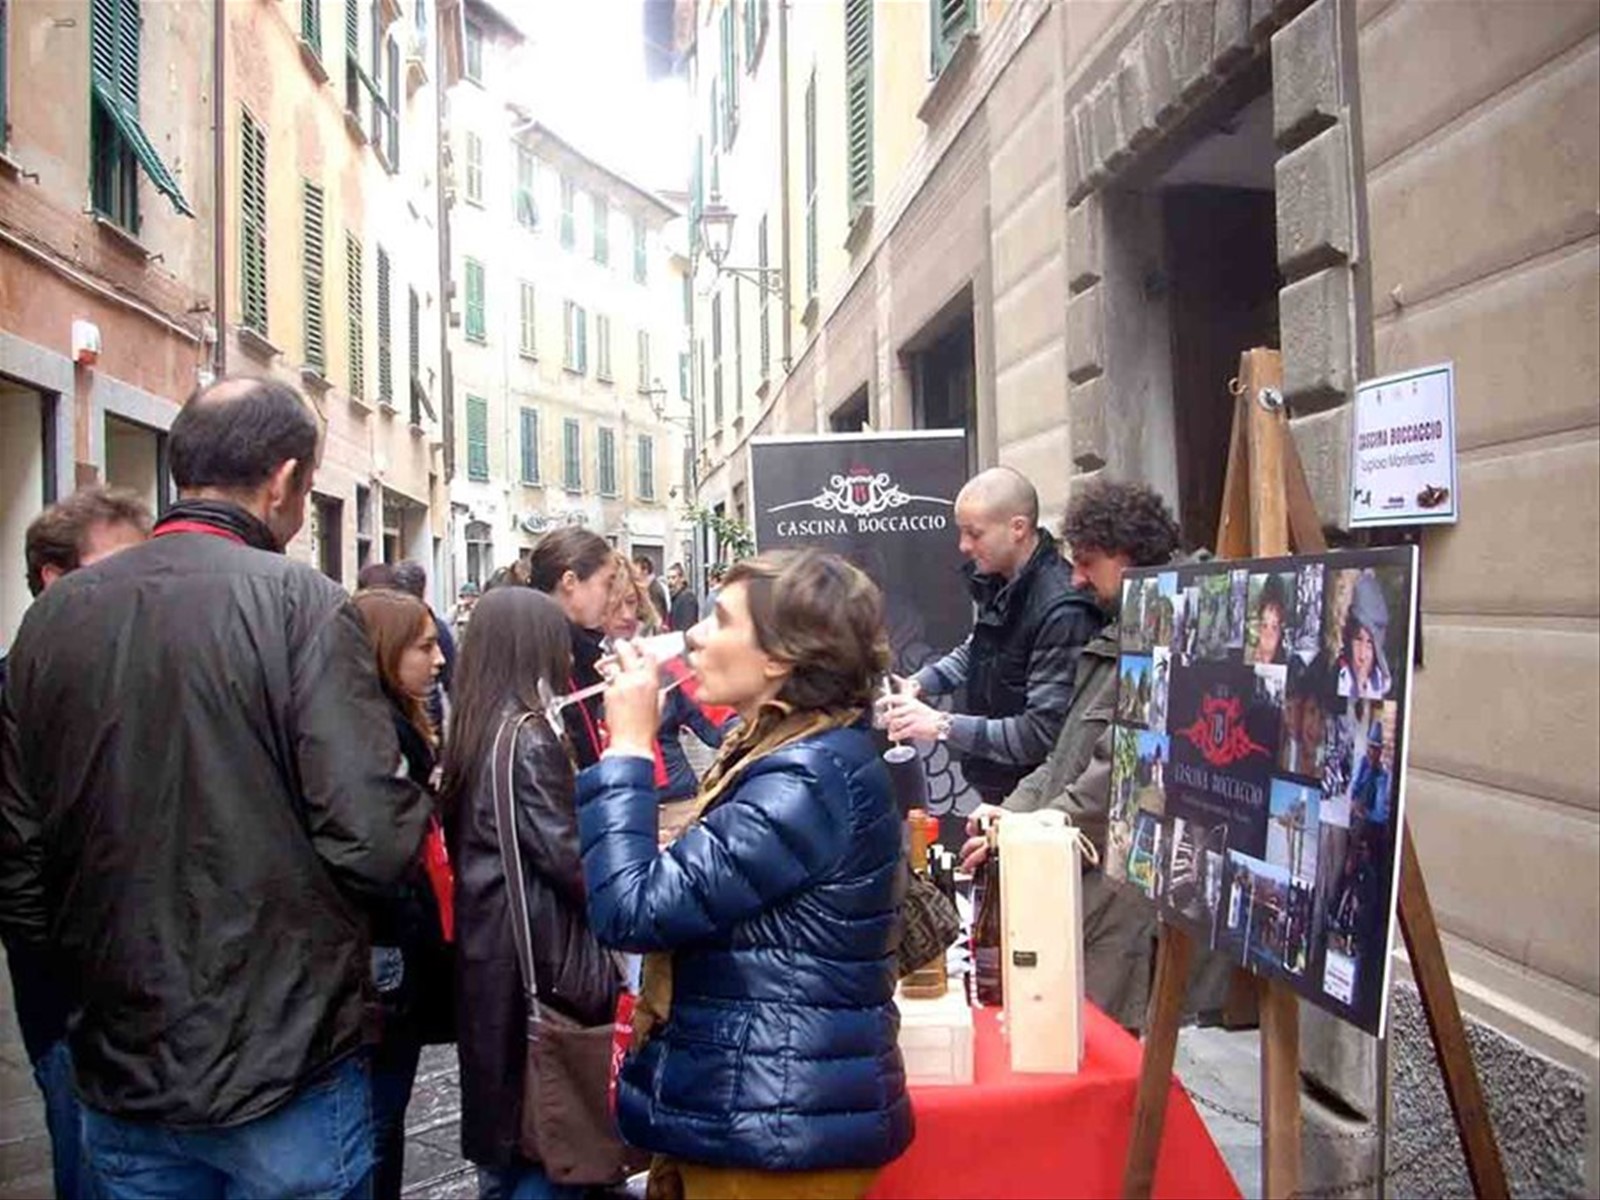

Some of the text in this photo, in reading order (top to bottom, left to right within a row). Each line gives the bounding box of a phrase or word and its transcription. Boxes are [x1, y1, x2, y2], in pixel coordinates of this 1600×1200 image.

[1390, 420, 1442, 446] BOCCACCIO
[777, 515, 946, 536] CASCINA BOCCACCIO
